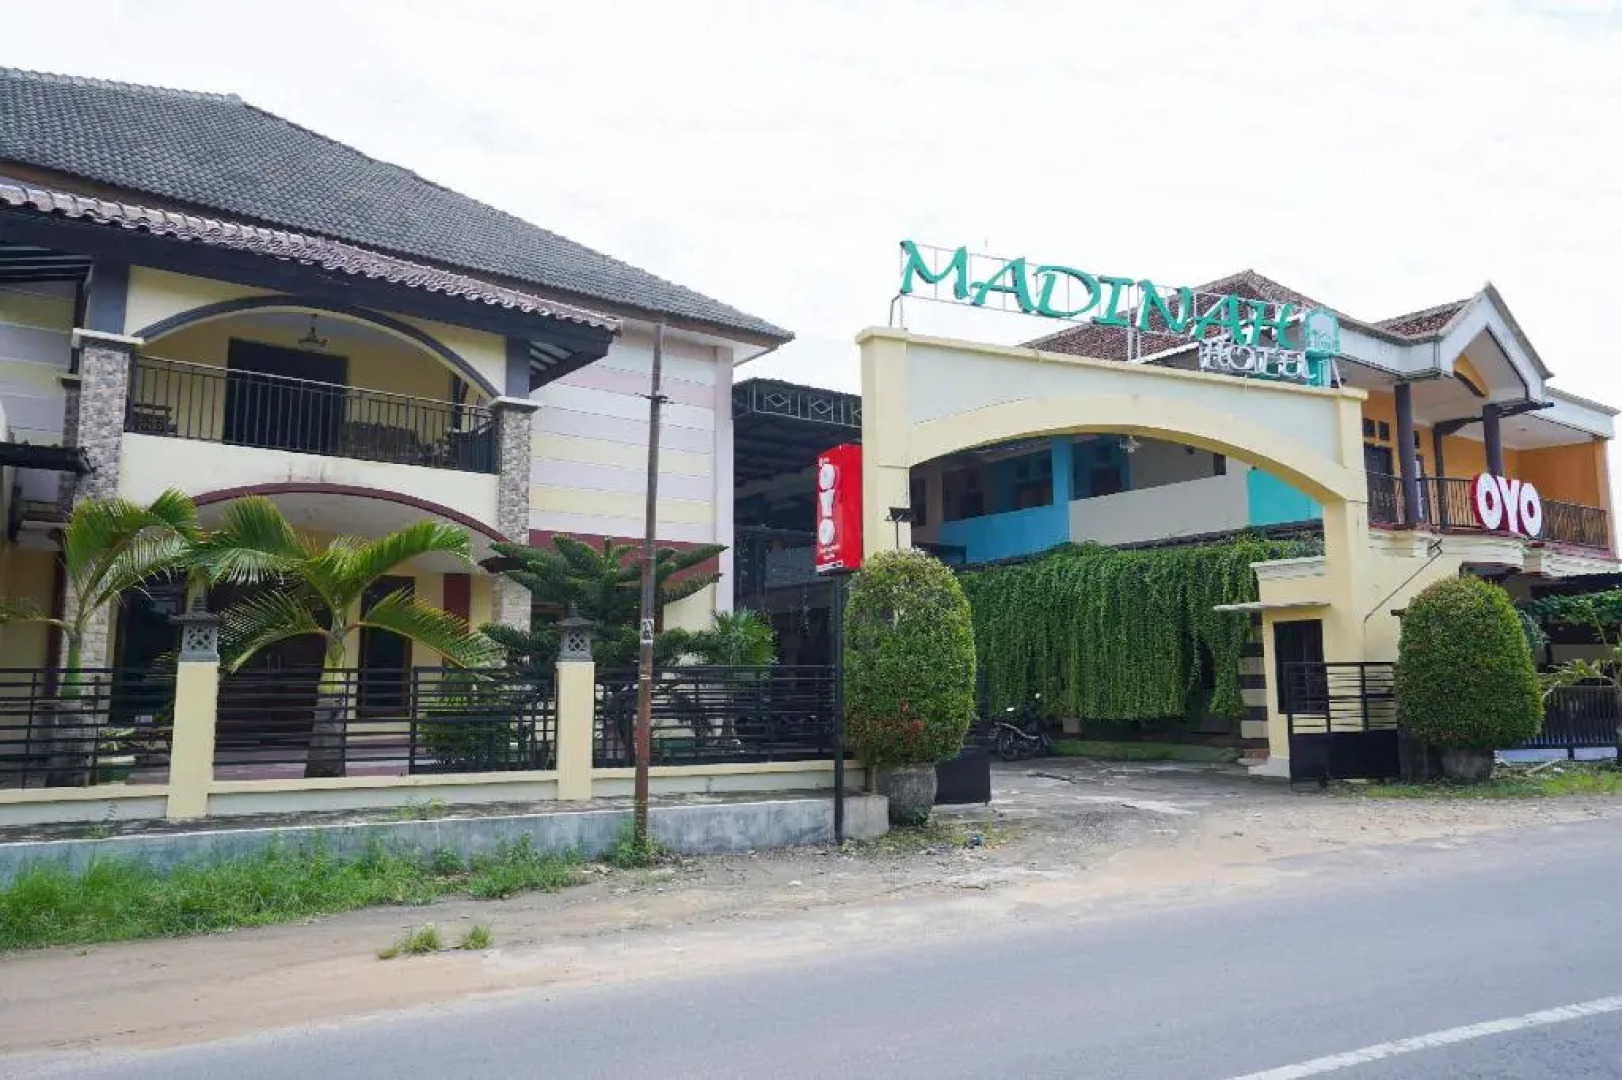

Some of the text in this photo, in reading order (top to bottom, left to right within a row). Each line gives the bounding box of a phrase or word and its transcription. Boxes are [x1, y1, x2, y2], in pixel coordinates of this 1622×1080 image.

[899, 240, 1296, 350] MADINAH
[1199, 338, 1316, 380] HOTEL
[819, 463, 836, 546] OYO
[1476, 472, 1542, 536] OYO
